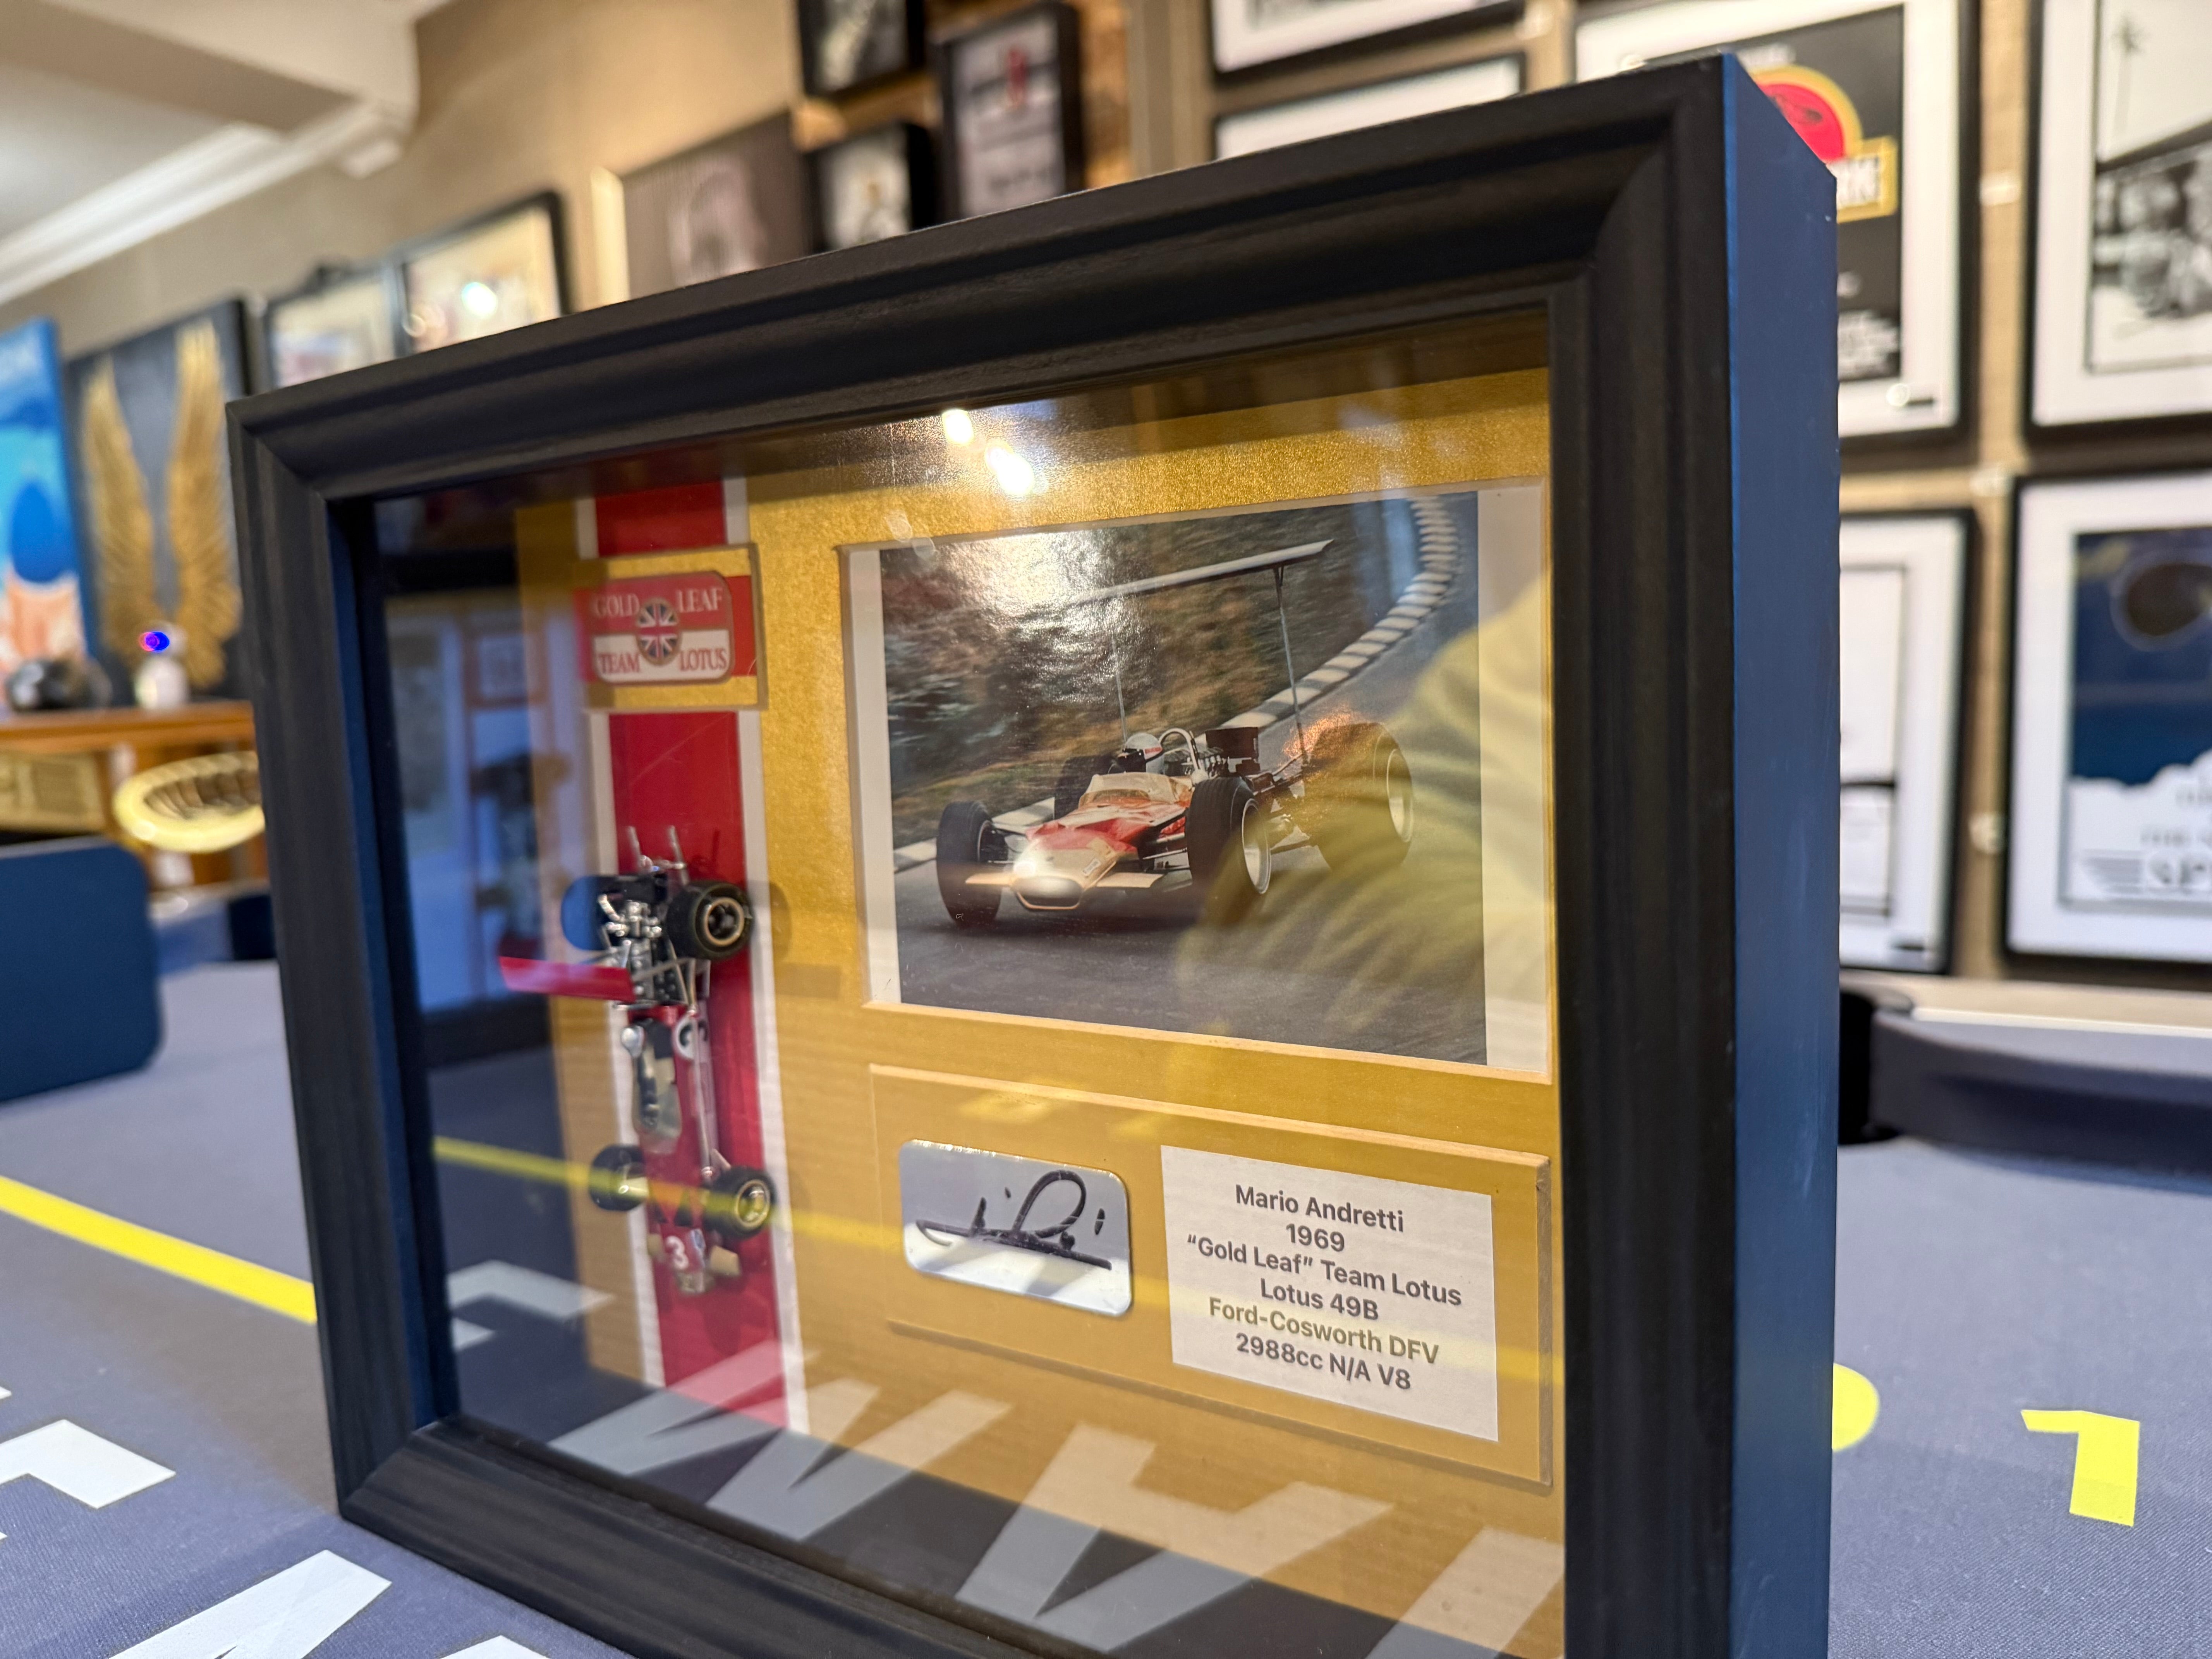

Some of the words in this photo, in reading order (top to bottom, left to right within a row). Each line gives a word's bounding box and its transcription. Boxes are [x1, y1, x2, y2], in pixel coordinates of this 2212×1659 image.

[594, 593, 640, 618] GOLD
[676, 587, 723, 613] LEAF
[598, 651, 641, 674] TEAM
[679, 648, 728, 672] LOTUS
[1235, 1184, 1299, 1214] Mario
[1305, 1197, 1404, 1232] Andretti
[665, 1235, 689, 1270] 3
[1285, 1223, 1345, 1252] 1969
[1187, 1233, 1247, 1264] “Gold
[1254, 1246, 1313, 1275] Leaf”
[1320, 1259, 1385, 1291] Team
[1392, 1273, 1462, 1306] Lotus
[1260, 1278, 1323, 1310] Lotus
[1330, 1293, 1379, 1321] 49B
[1209, 1296, 1382, 1353] Ford-Cosworth
[1389, 1335, 1439, 1364] DFV
[1236, 1333, 1323, 1370] 2988cc
[1330, 1352, 1370, 1382] N/A
[1378, 1364, 1412, 1391] V8
